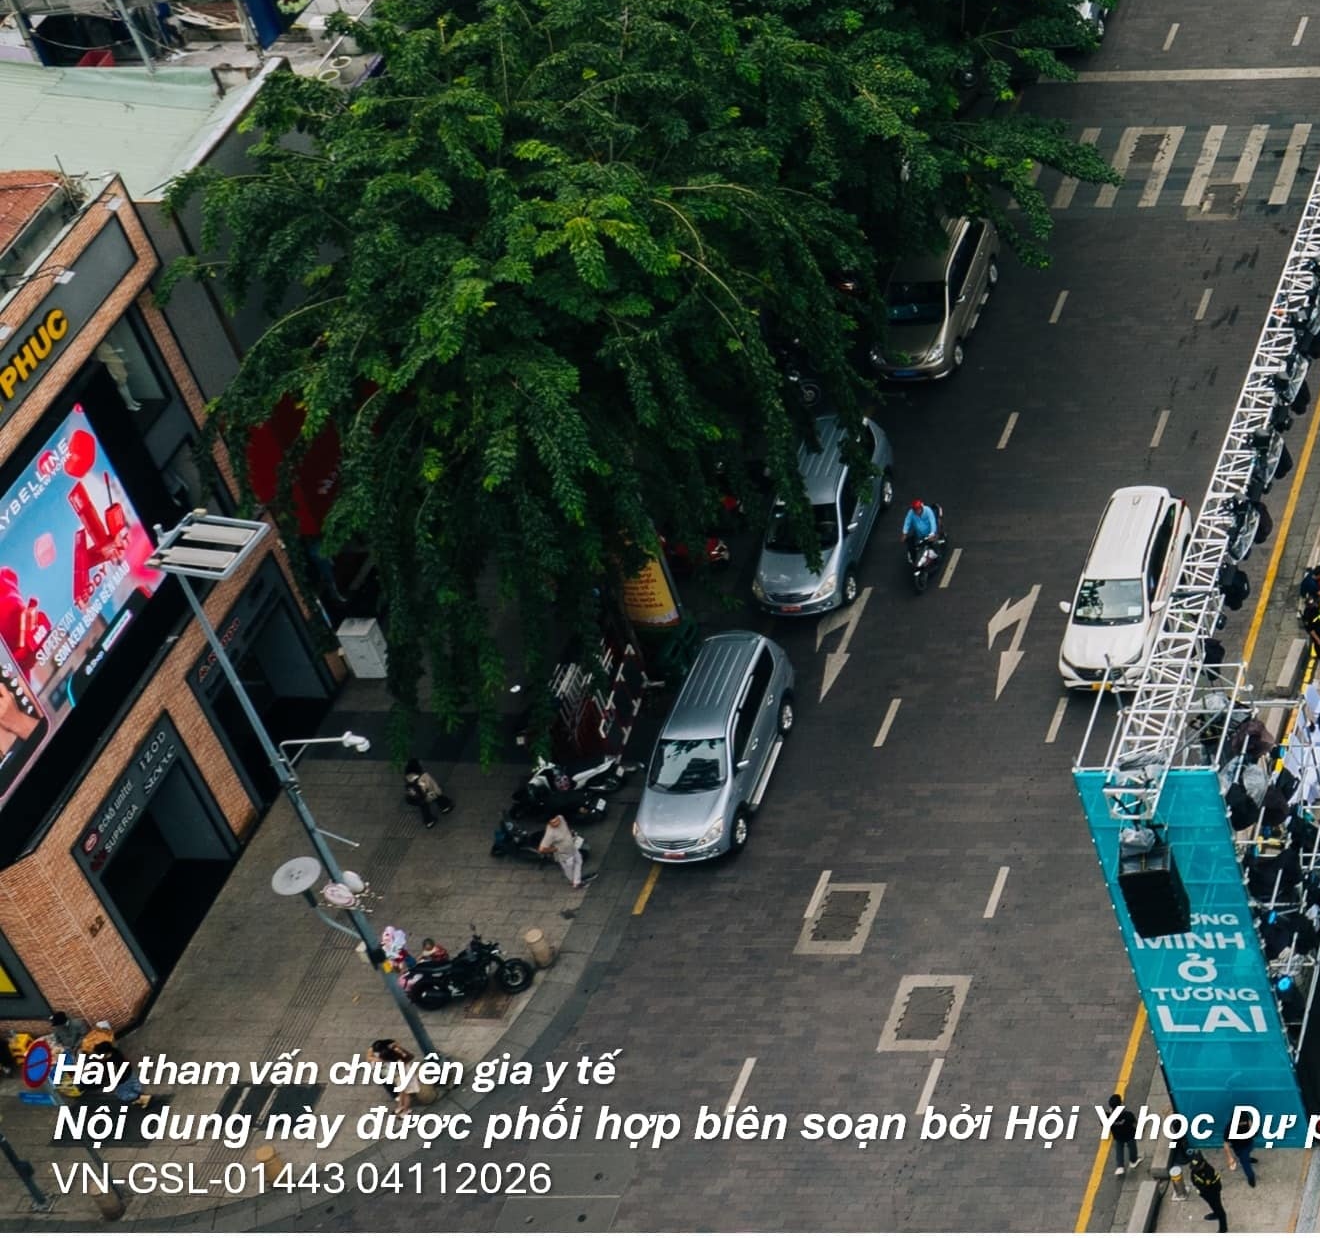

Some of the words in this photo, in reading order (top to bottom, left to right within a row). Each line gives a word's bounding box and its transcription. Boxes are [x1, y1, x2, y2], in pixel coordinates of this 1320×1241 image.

[0, 309, 68, 400] PHUC
[104, 804, 138, 854] SUPERGA
[1178, 953, 1218, 983] Ở
[1151, 986, 1260, 1002] TƯƠNG
[1158, 1005, 1269, 1033] LAI
